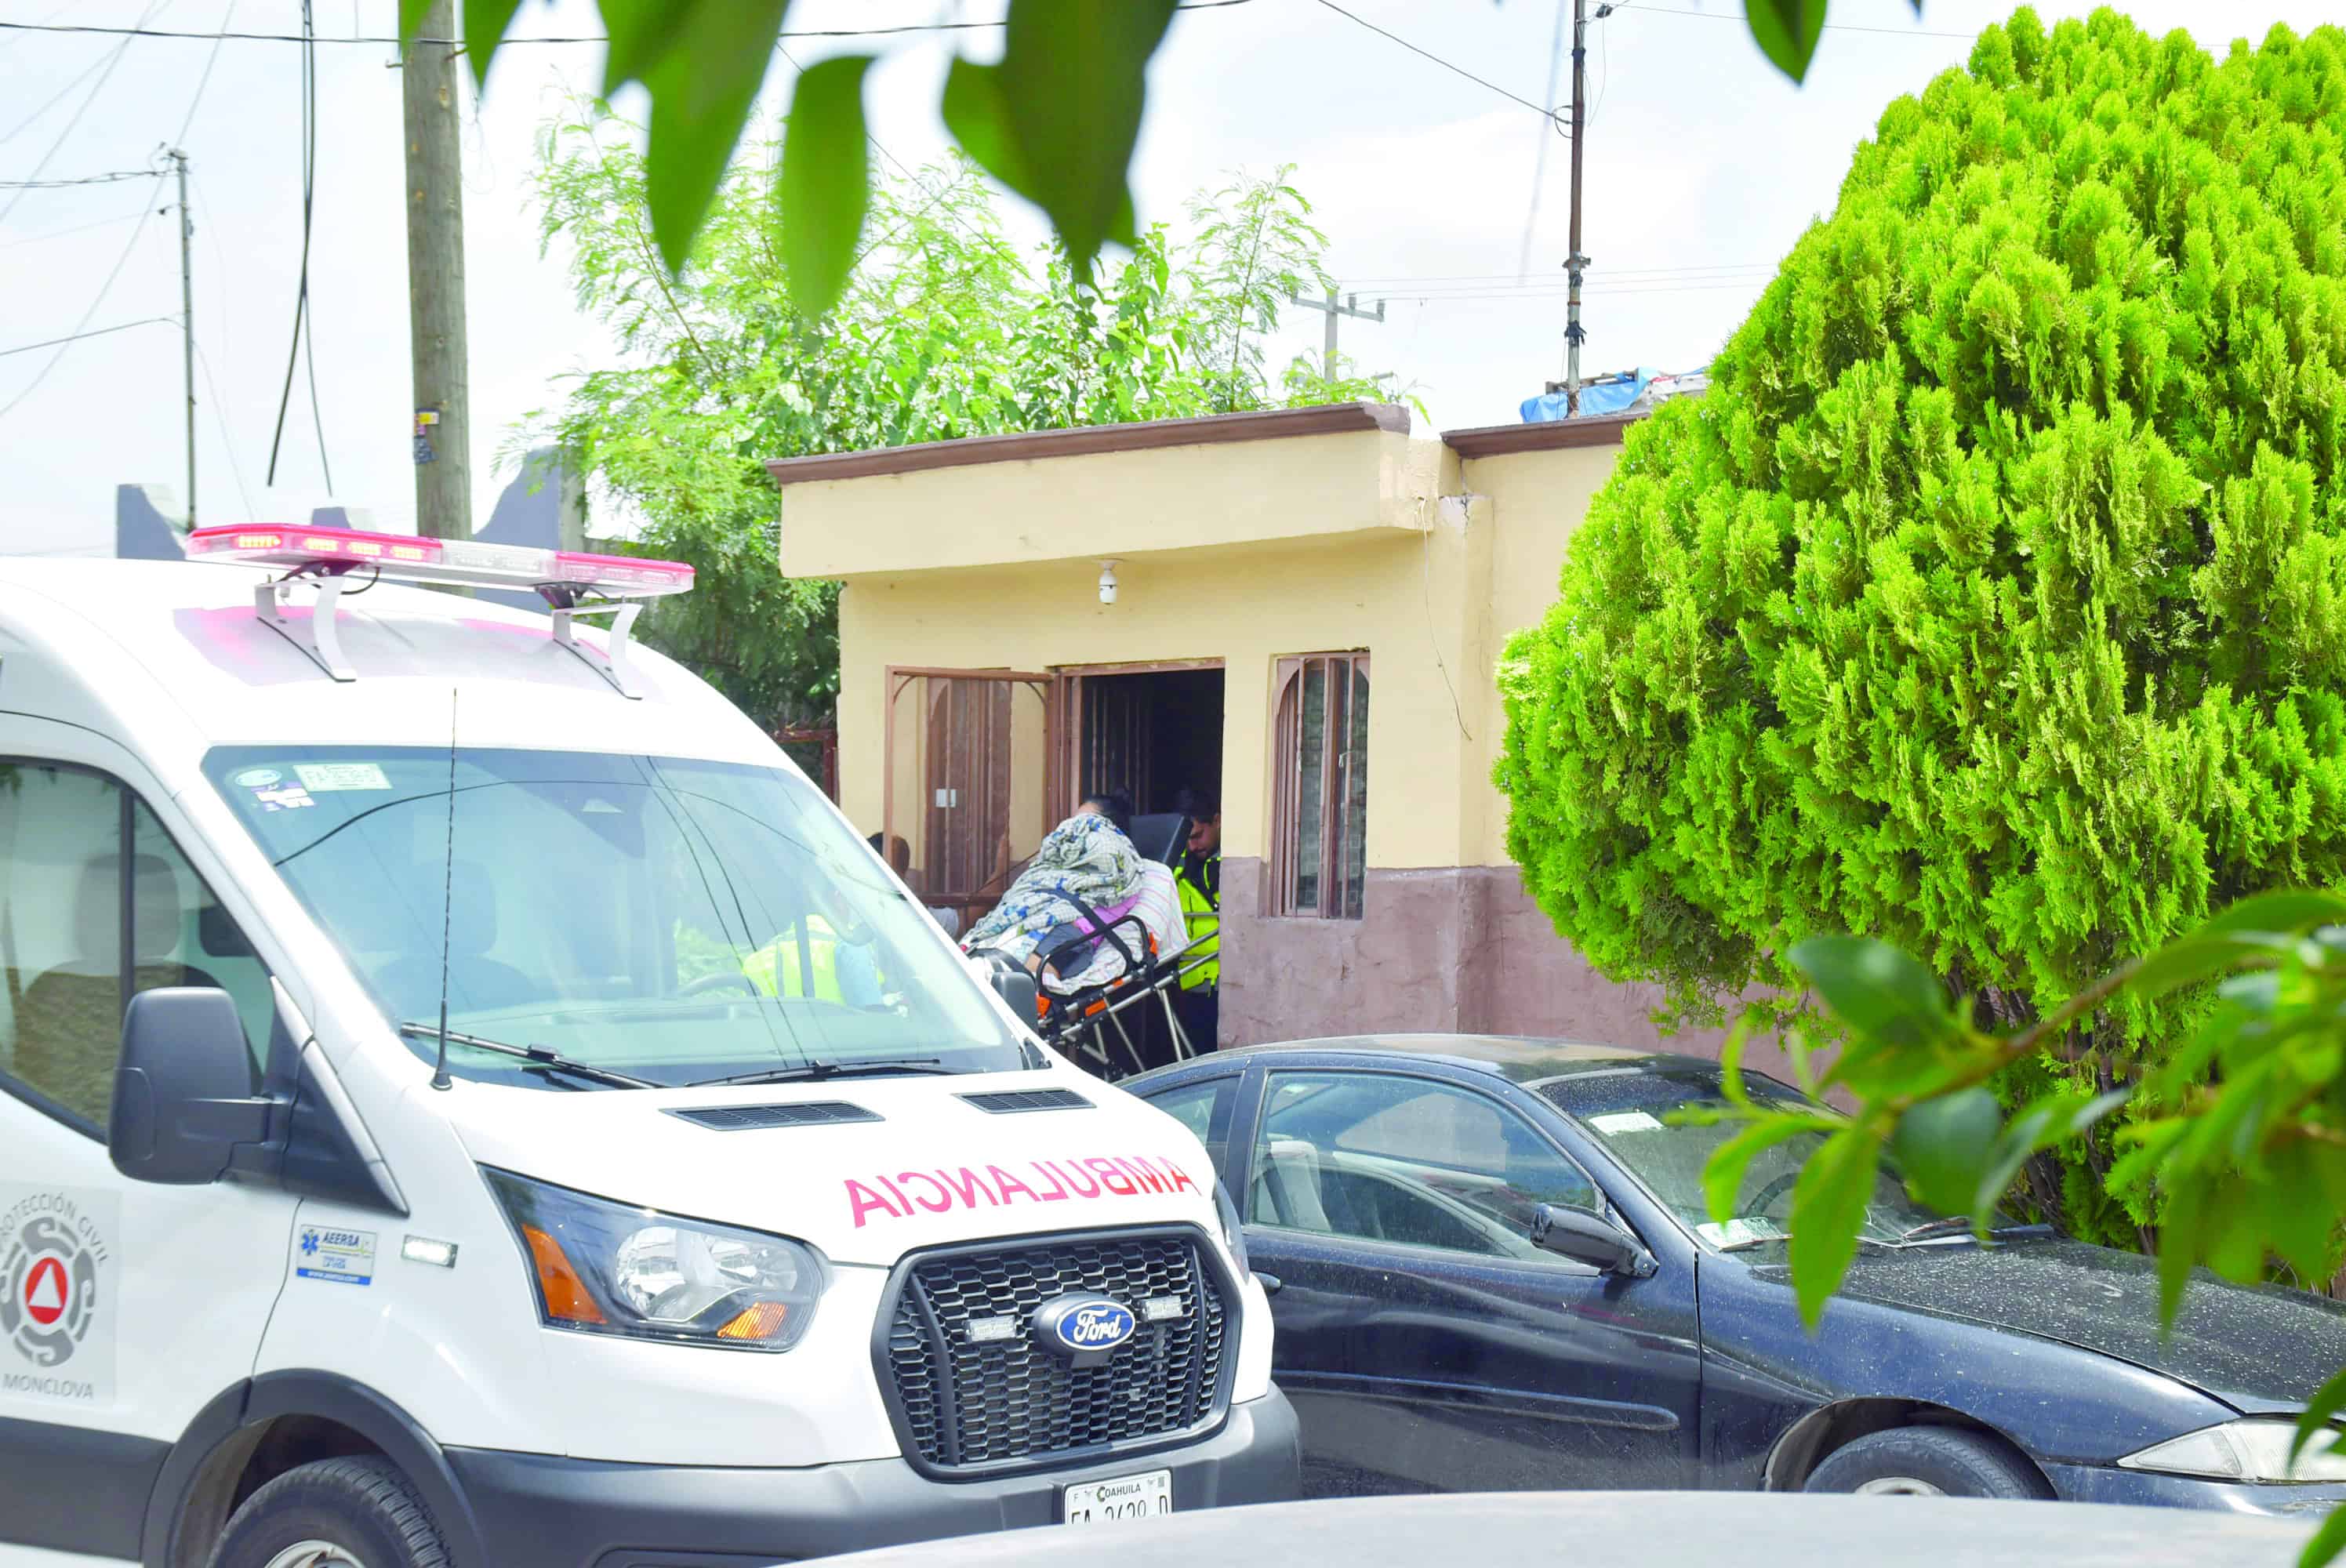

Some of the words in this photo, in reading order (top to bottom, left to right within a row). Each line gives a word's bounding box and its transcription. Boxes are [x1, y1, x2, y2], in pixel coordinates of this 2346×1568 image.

[78, 1216, 108, 1268] CIVIL
[1073, 1309, 1121, 1343] Ford
[2, 1373, 93, 1399] MONCLOVA
